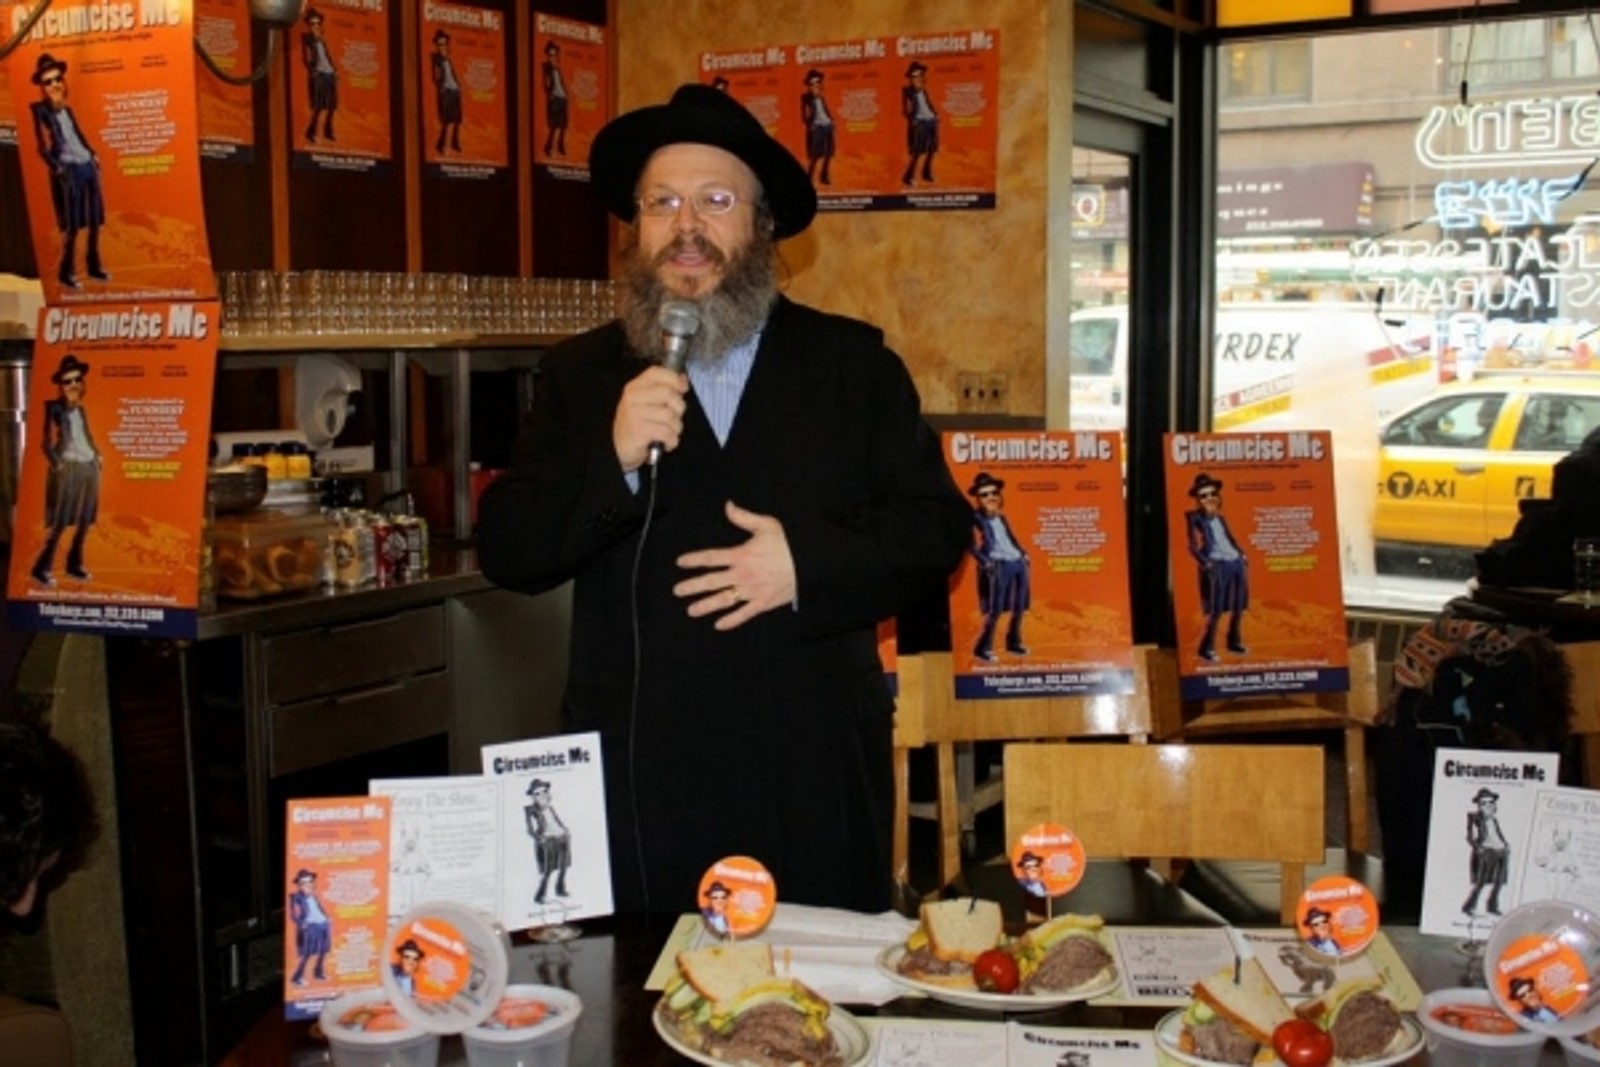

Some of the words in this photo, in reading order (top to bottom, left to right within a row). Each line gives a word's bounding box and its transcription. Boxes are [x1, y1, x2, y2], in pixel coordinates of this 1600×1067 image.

[11, 0, 135, 44] Circumcise
[140, 0, 181, 27] Me
[45, 304, 162, 343] Circumcise
[169, 299, 207, 339] Me
[952, 431, 1070, 463] Circumcise
[1076, 431, 1111, 460] Me
[1172, 433, 1284, 465] Circumcise
[1288, 431, 1324, 460] Me
[1387, 472, 1456, 499] TAXI
[493, 751, 566, 775] Circumcise
[568, 747, 590, 763] Me
[1444, 760, 1519, 780] Circumcise
[1523, 764, 1545, 782] Me
